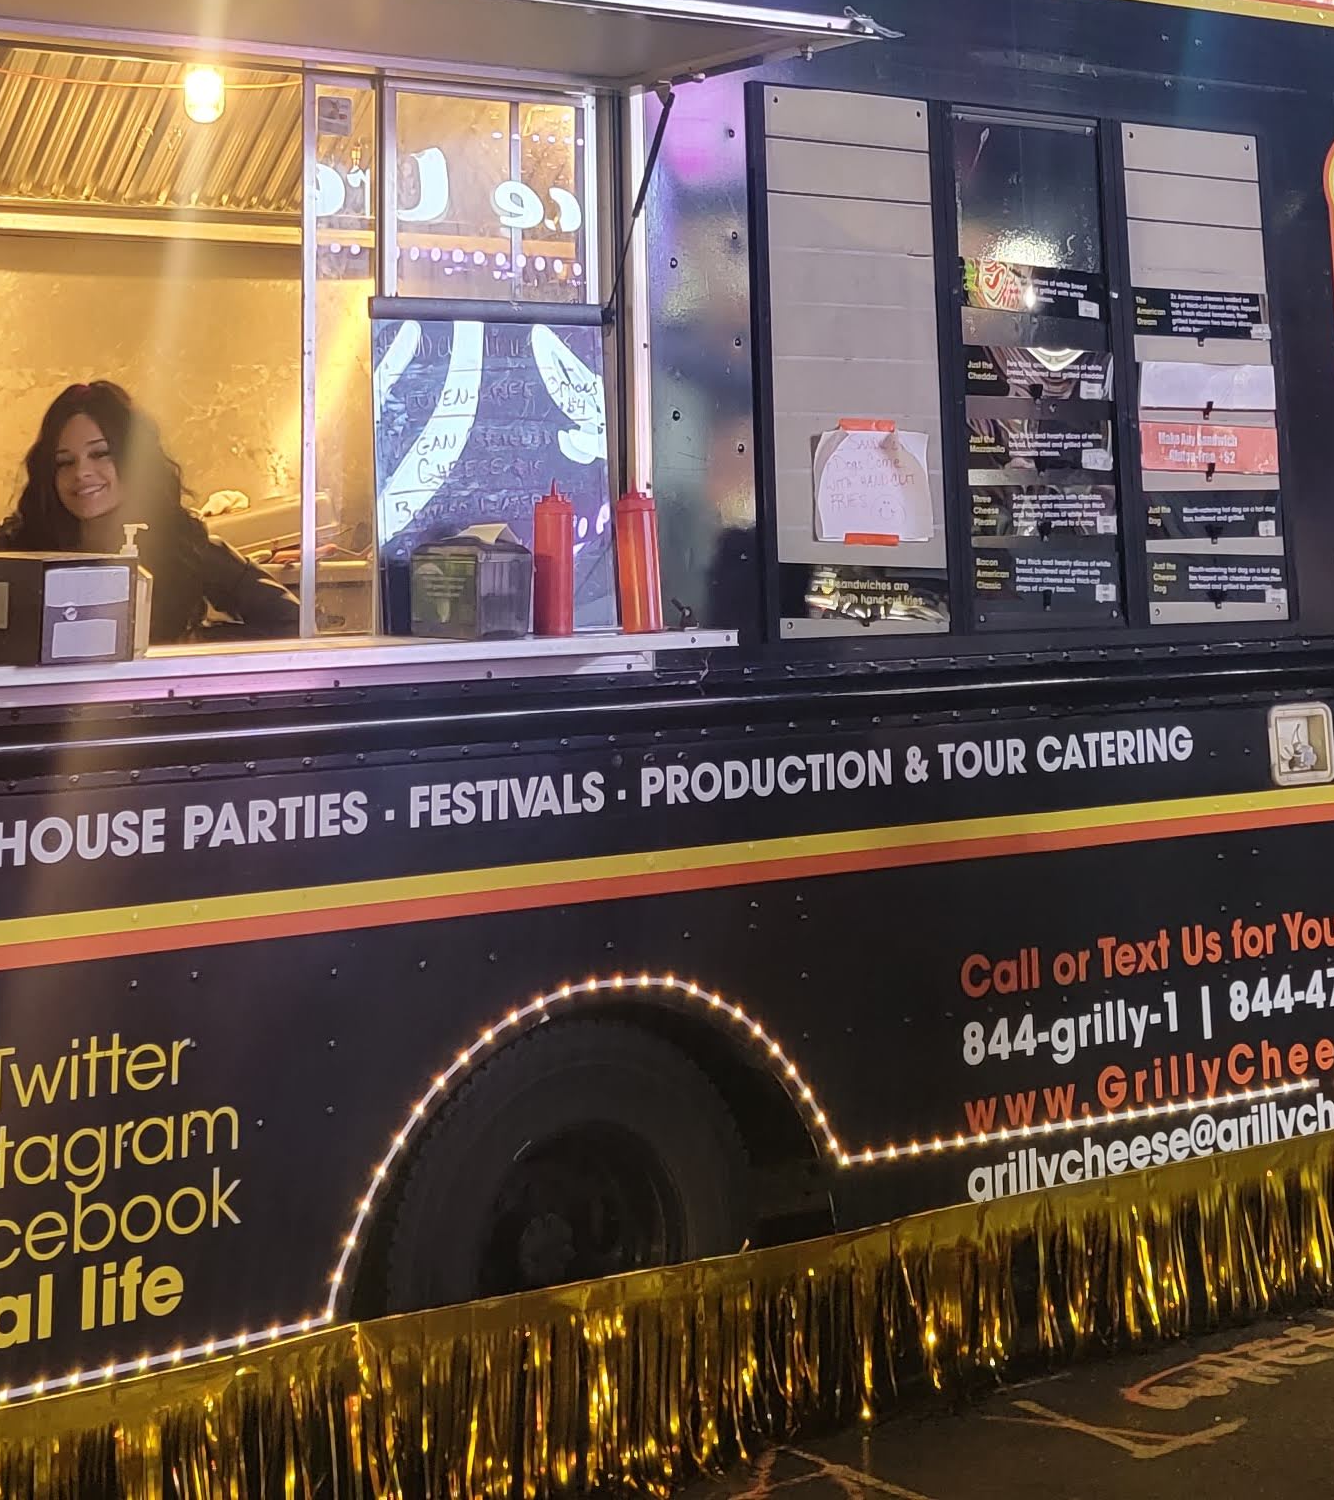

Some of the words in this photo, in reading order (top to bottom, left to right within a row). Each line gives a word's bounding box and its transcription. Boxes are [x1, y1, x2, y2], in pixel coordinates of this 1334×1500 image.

[894, 582, 909, 590] are
[183, 792, 368, 853] PARTIES
[408, 771, 606, 831] FESTIVALS
[639, 747, 894, 807] PRODUCTION
[904, 744, 929, 782] &
[936, 736, 1027, 780] TOUR
[1043, 725, 1194, 771] CATERING
[960, 946, 1041, 999] Call
[1053, 950, 1091, 985] or
[1097, 928, 1170, 978] Text
[1182, 924, 1222, 967] Us
[1231, 917, 1277, 960] for
[962, 990, 1179, 1066] 844-grilly-1
[80, 1254, 185, 1332] life
